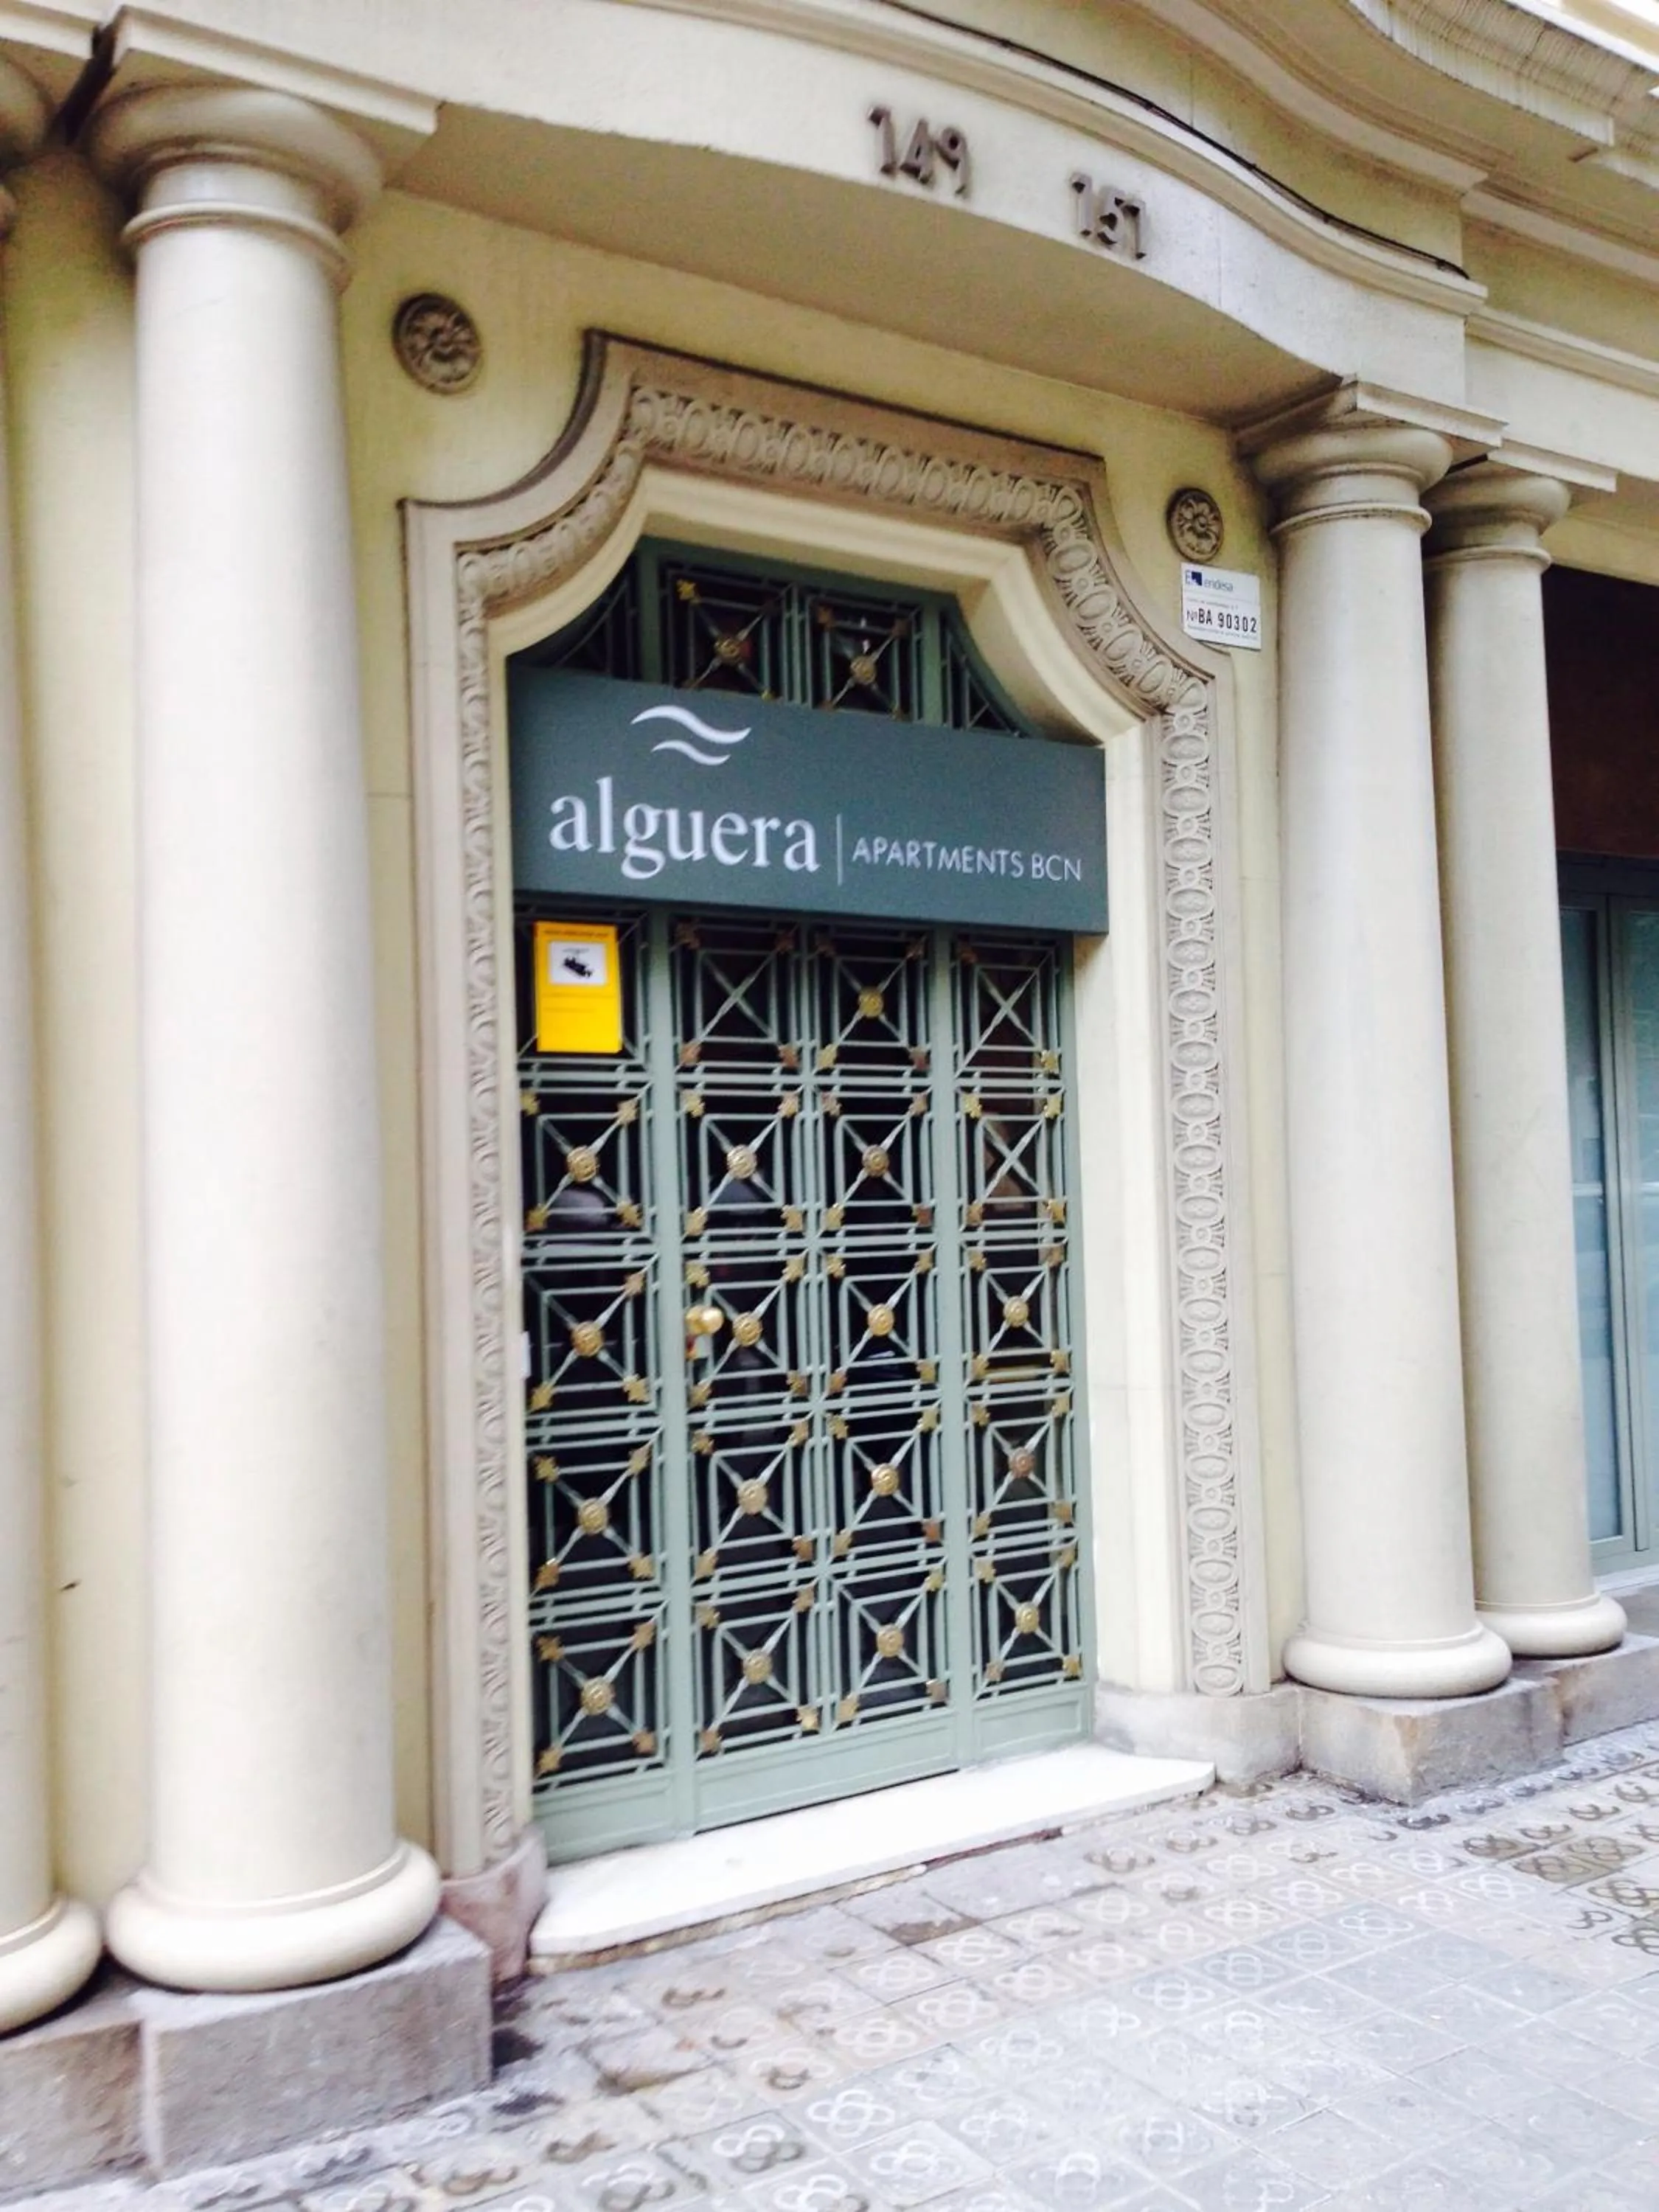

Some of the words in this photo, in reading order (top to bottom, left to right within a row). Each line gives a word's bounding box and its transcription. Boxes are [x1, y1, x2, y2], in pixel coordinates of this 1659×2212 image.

[869, 106, 969, 195] 149
[1069, 173, 1146, 260] 151
[1217, 613, 1256, 633] 90302
[549, 776, 821, 880] alguera
[852, 836, 1024, 877] APARTMENTS
[1032, 852, 1081, 881] BCN
